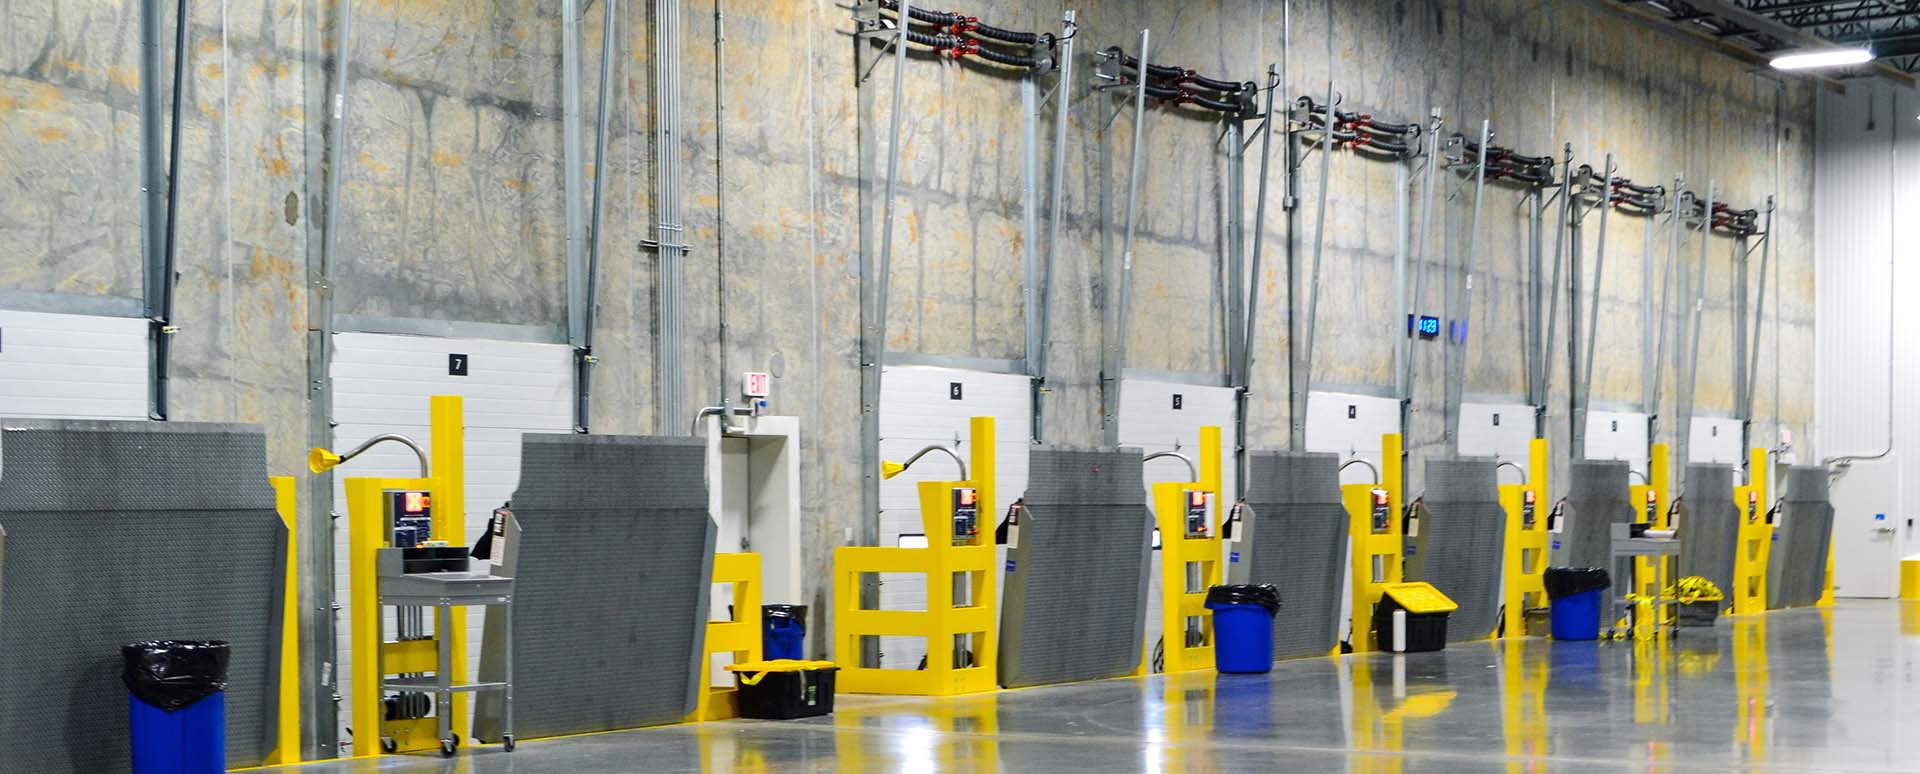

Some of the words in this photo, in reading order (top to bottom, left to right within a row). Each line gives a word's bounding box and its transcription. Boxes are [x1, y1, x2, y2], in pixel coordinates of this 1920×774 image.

[455, 358, 462, 370] 7
[953, 386, 960, 396] 6
[1175, 397, 1180, 406] 5
